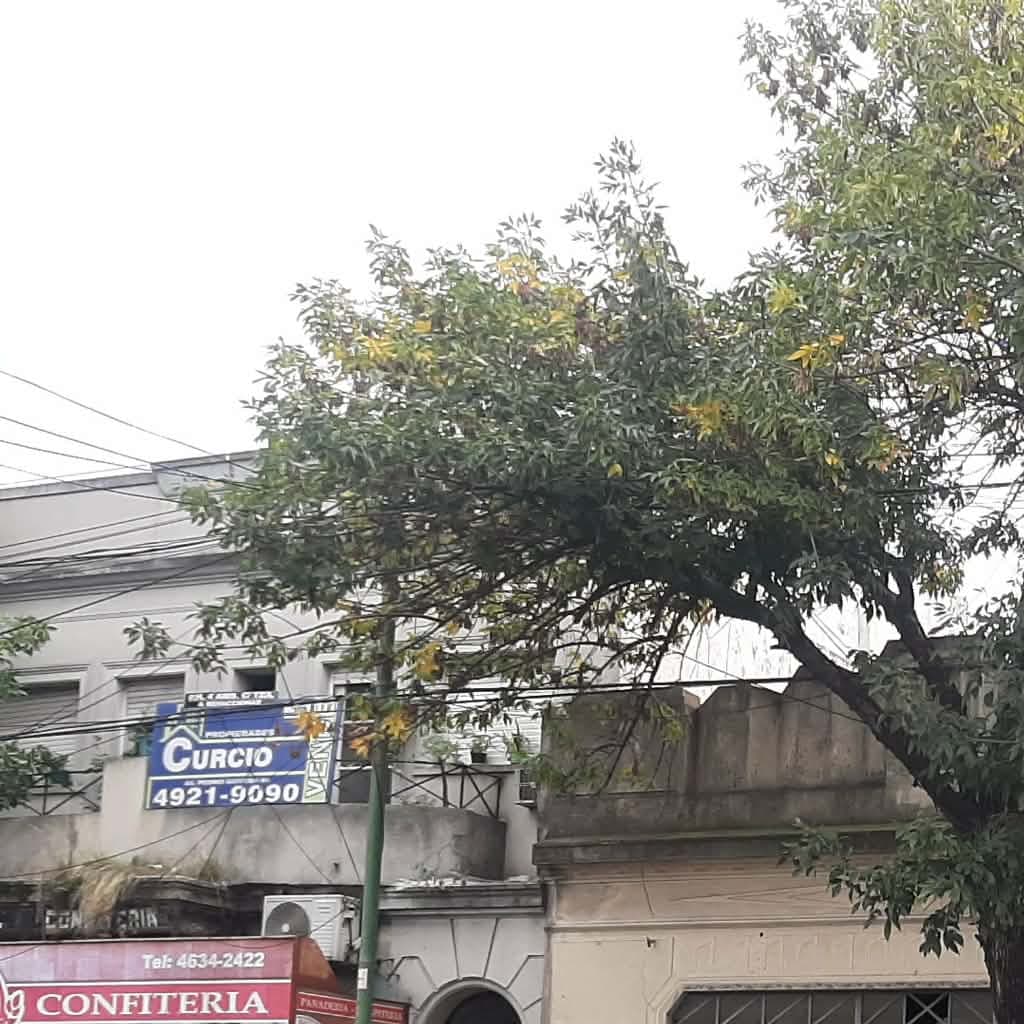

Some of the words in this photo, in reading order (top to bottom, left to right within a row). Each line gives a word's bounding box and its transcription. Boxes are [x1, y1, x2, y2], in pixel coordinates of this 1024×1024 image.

[162, 736, 273, 773] CURCIO
[152, 783, 299, 807] 4921-9090
[142, 954, 173, 969] Tel:
[176, 952, 265, 969] 4634-2422
[36, 991, 269, 1016] CONFITERIA
